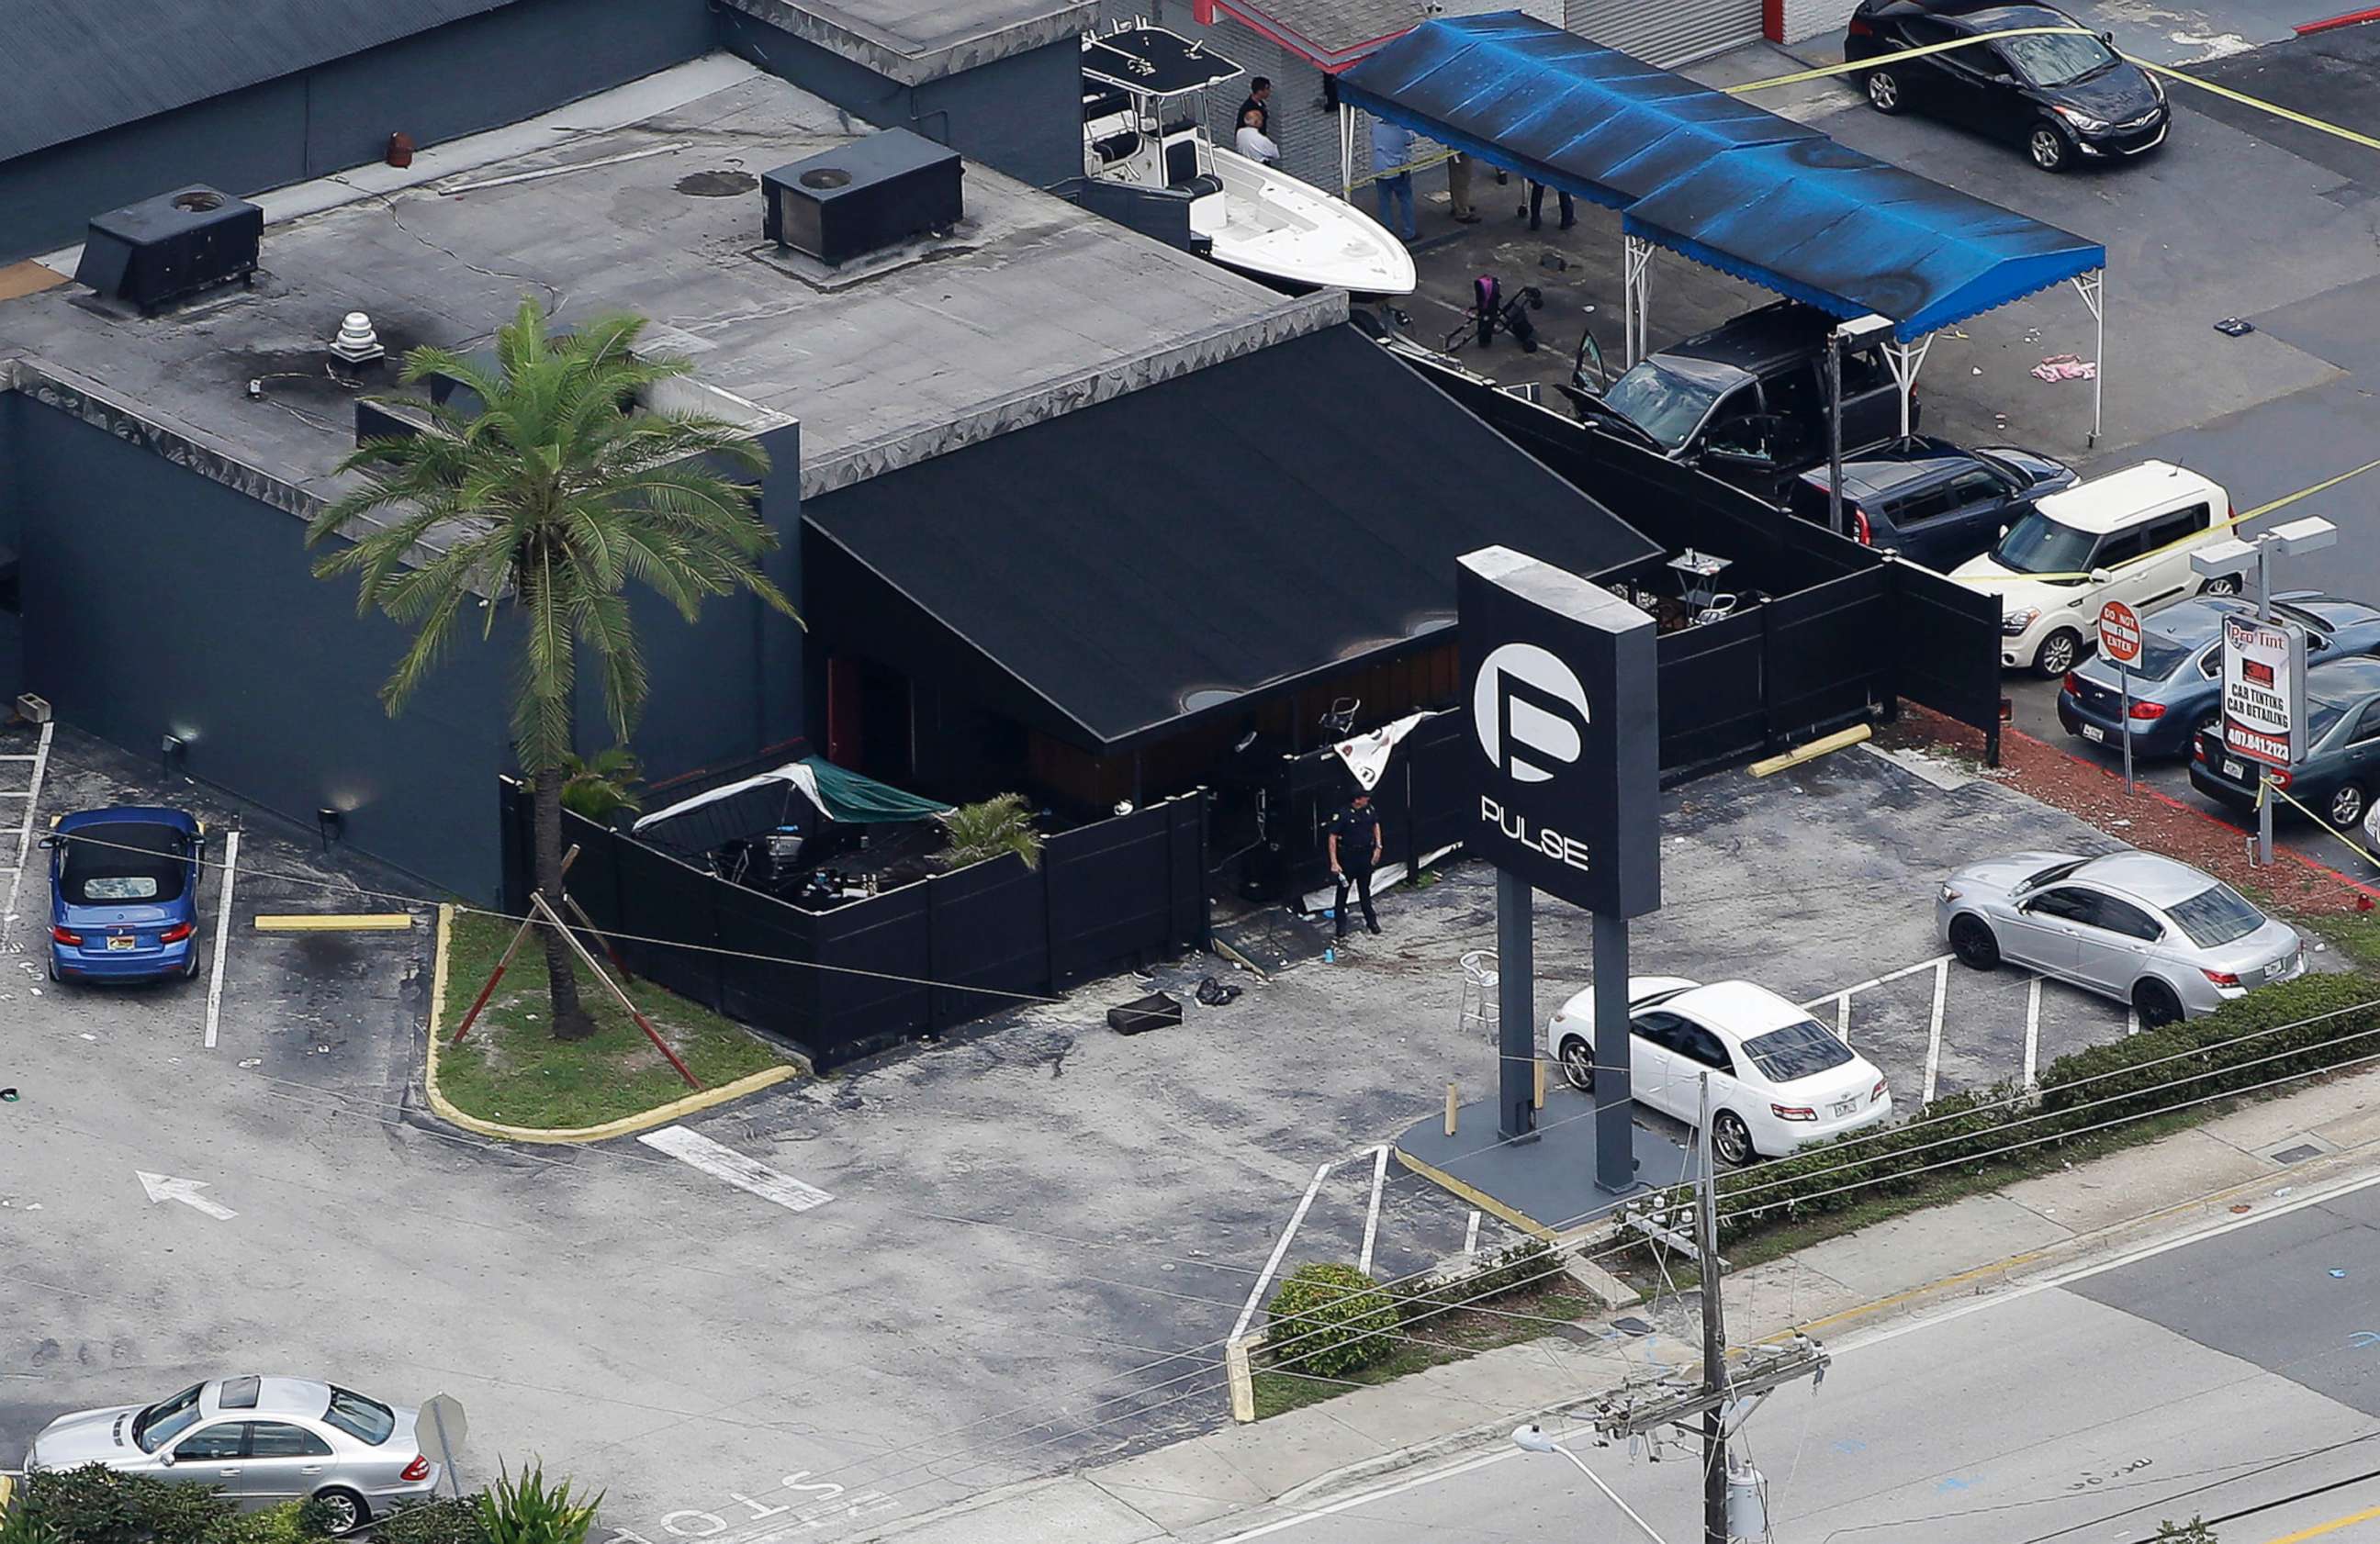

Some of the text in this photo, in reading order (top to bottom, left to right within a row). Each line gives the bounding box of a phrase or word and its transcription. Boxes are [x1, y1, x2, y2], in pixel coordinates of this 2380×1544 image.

[2105, 608, 2134, 628] DO NOT
[2107, 635, 2132, 653] ENTER
[2231, 626, 2285, 650] Pro Tint
[2232, 683, 2284, 711] CAR TINTING
[2228, 698, 2288, 728] CAR DETAILING
[1481, 795, 1589, 872] PULSE
